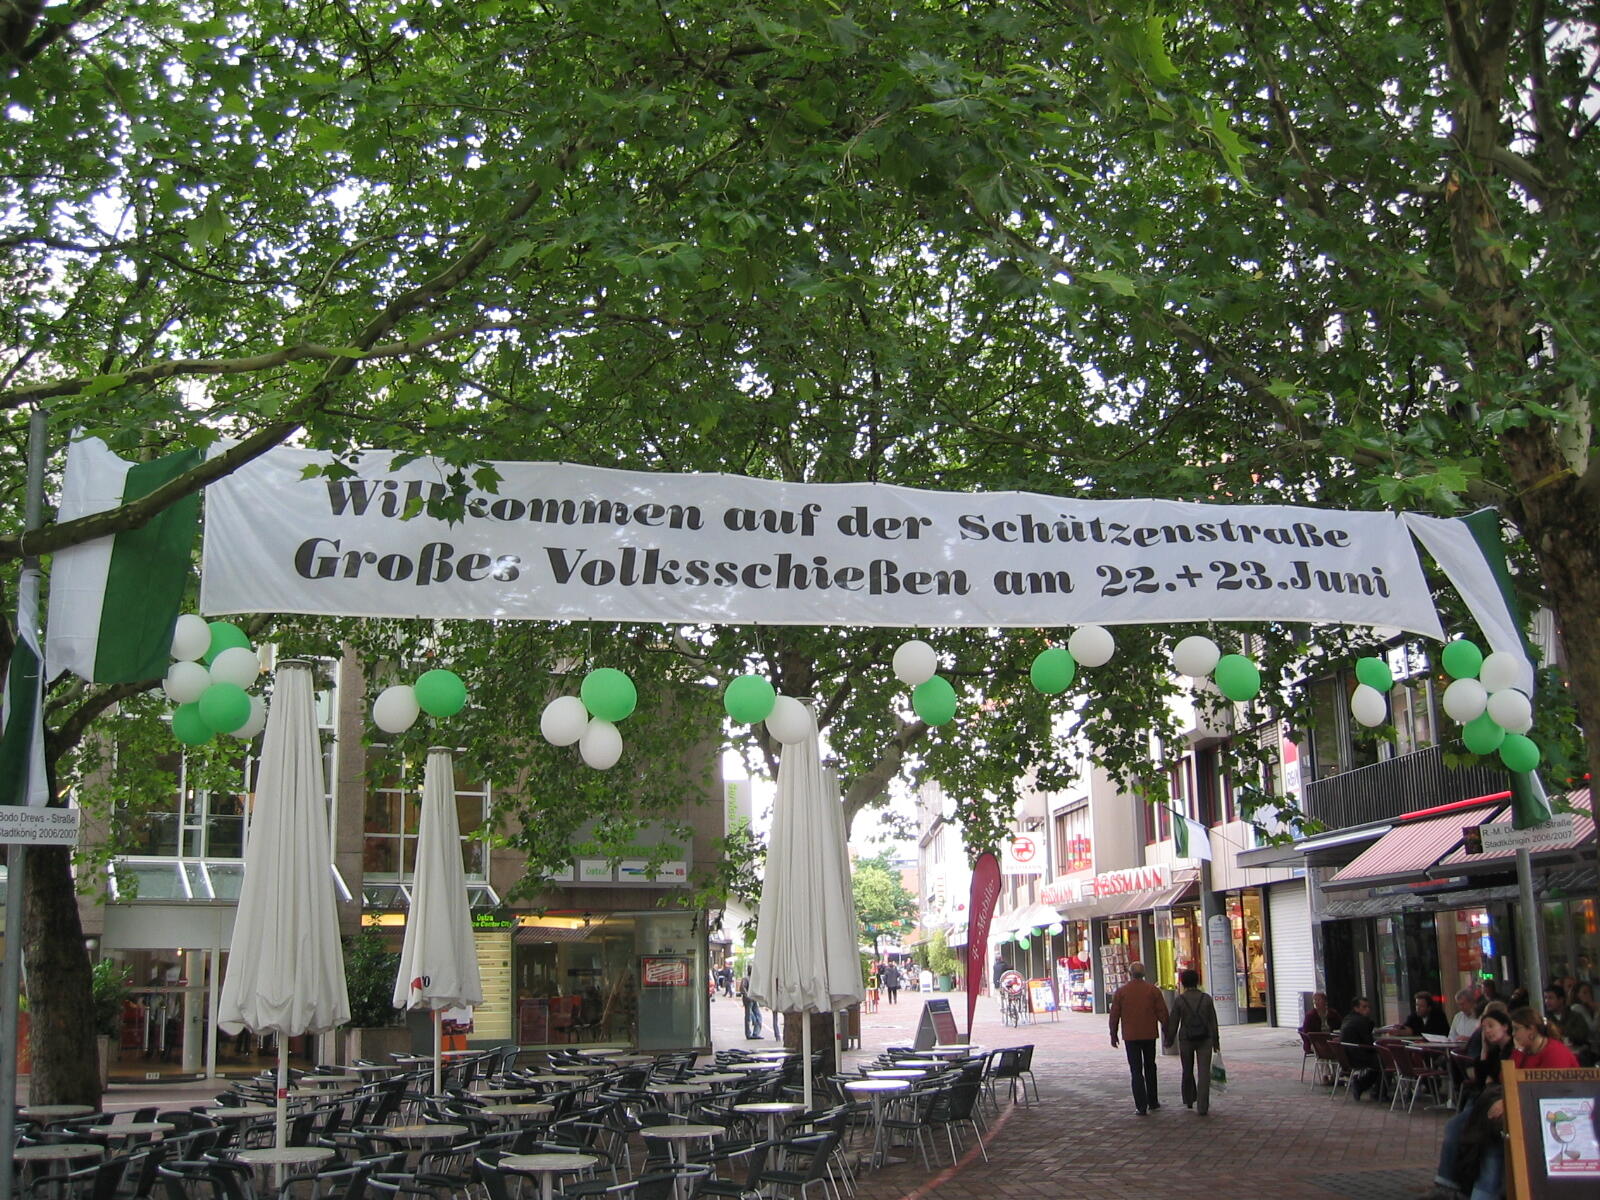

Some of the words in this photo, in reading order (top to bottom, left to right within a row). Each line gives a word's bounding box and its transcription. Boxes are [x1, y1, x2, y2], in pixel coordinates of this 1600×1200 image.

[723, 503, 823, 537] auf
[837, 506, 933, 540] der
[958, 513, 1351, 548] Schützenstraße
[294, 537, 521, 586] Großes
[542, 546, 972, 596] Volksschießen
[993, 569, 1076, 595] am
[21, 812, 45, 823] Drews
[0, 828, 37, 840] tadtkönig
[39, 829, 78, 839] 2006/2007
